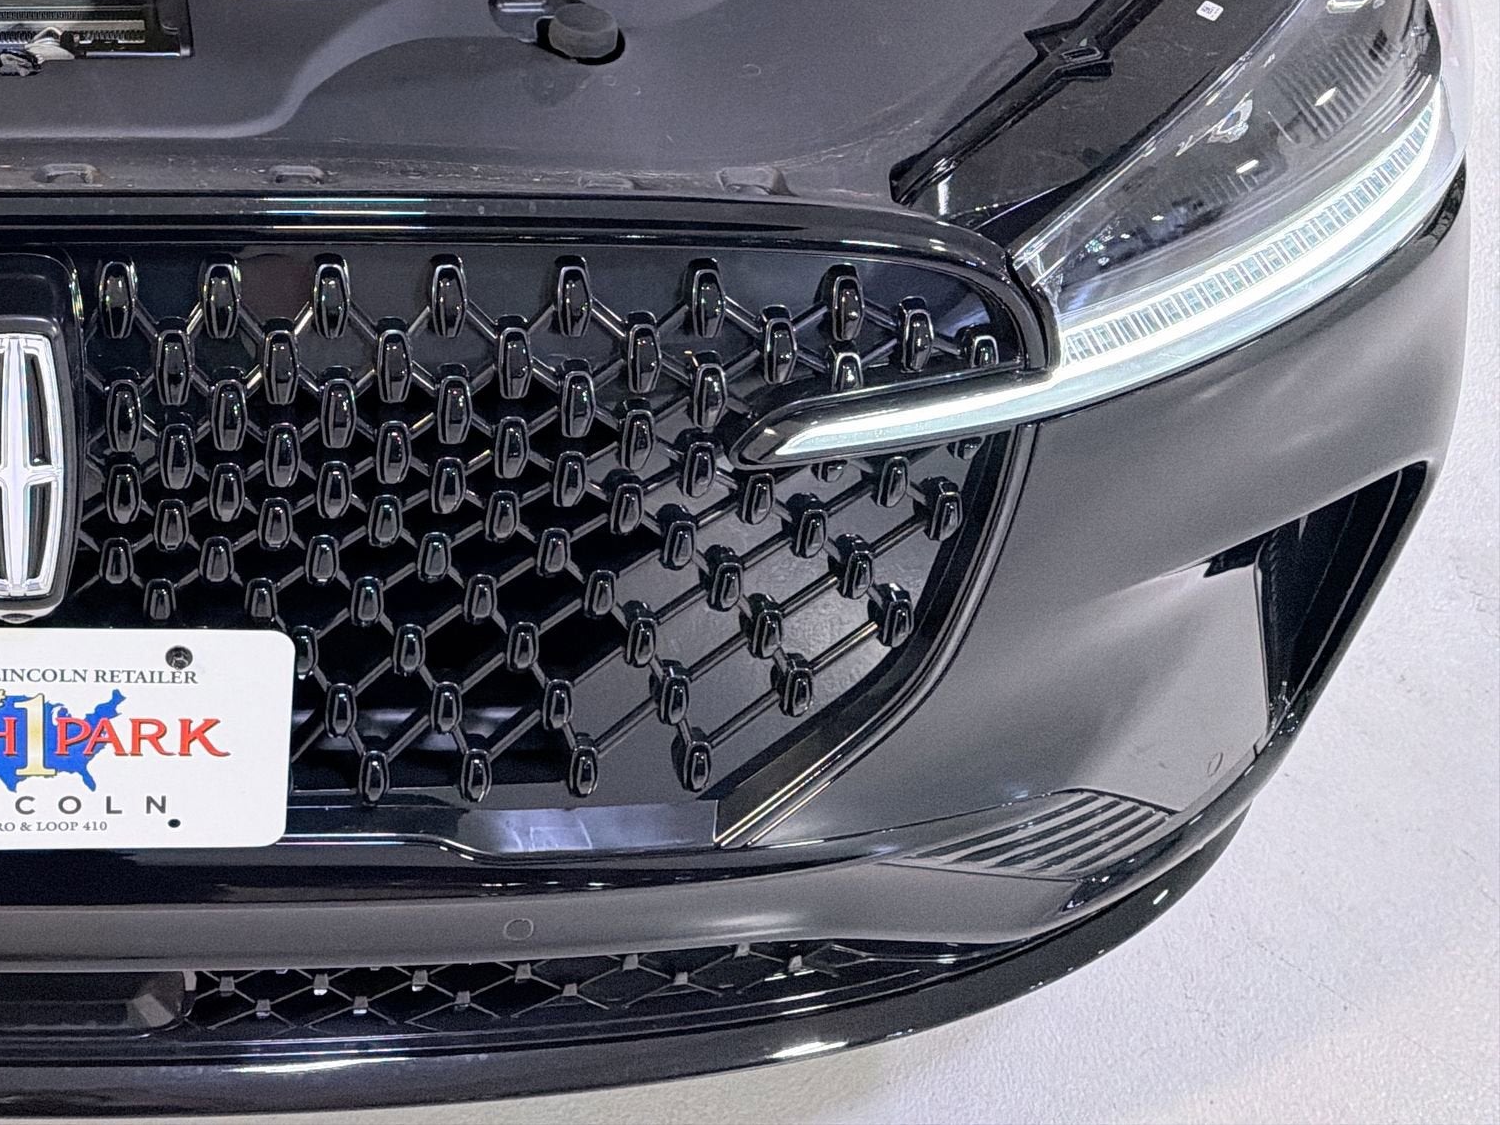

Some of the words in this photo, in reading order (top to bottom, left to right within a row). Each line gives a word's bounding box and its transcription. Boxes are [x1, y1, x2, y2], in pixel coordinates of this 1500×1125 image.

[94, 669, 199, 685] RETAILER
[55, 716, 232, 758] PARK
[19, 821, 31, 832] &
[36, 821, 79, 832] LOOP
[83, 820, 108, 832] 410
